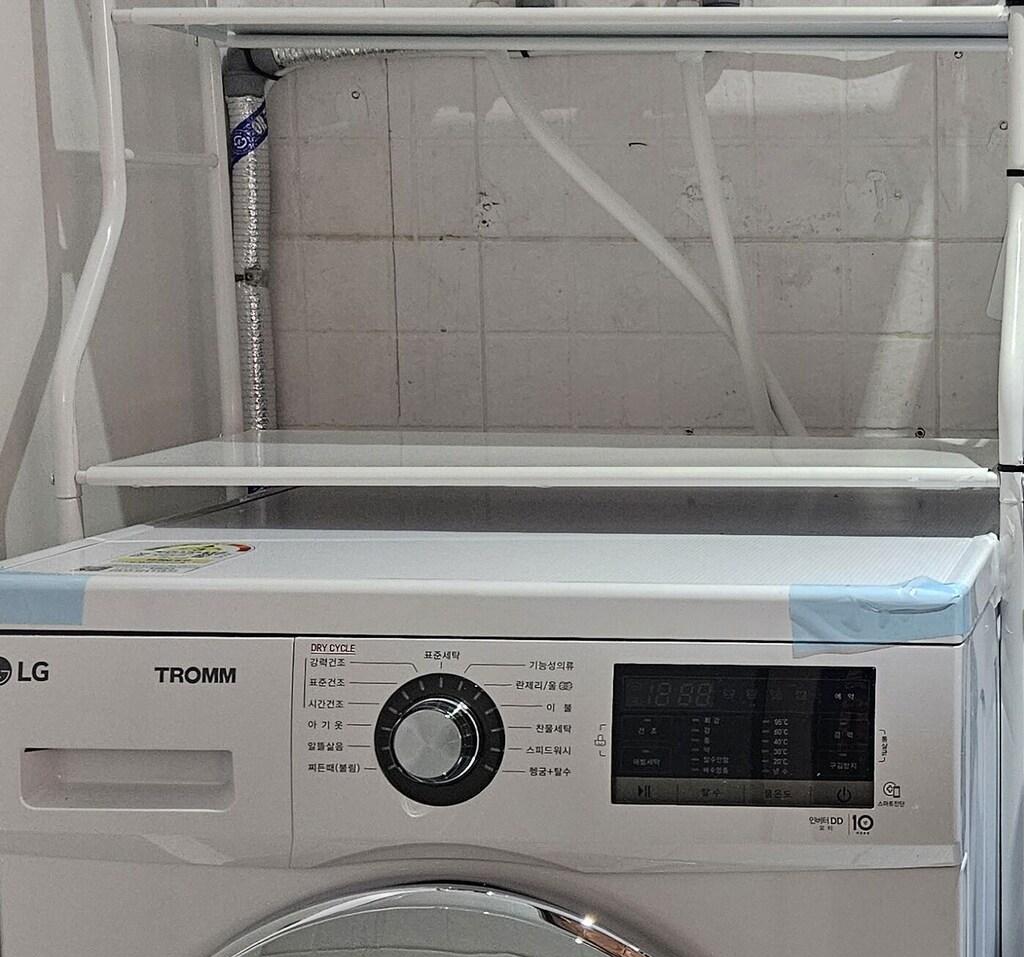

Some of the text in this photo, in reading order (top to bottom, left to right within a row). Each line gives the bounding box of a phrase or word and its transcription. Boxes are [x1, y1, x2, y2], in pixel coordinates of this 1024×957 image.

[310, 643, 356, 653] DRY CYCLE
[424, 650, 461, 660] 표준세탁
[310, 658, 346, 667] 강력건조
[528, 661, 575, 670] 기능성의류
[18, 661, 49, 682] LG
[154, 667, 237, 684] TROMM
[309, 678, 345, 687] 표준건조
[307, 699, 344, 709] 시간건조
[535, 723, 572, 733] 찬물세탁
[307, 741, 344, 751] 알뜰삶음
[526, 745, 572, 755] 스피드워시
[529, 766, 572, 777] 헹굼+탈수
